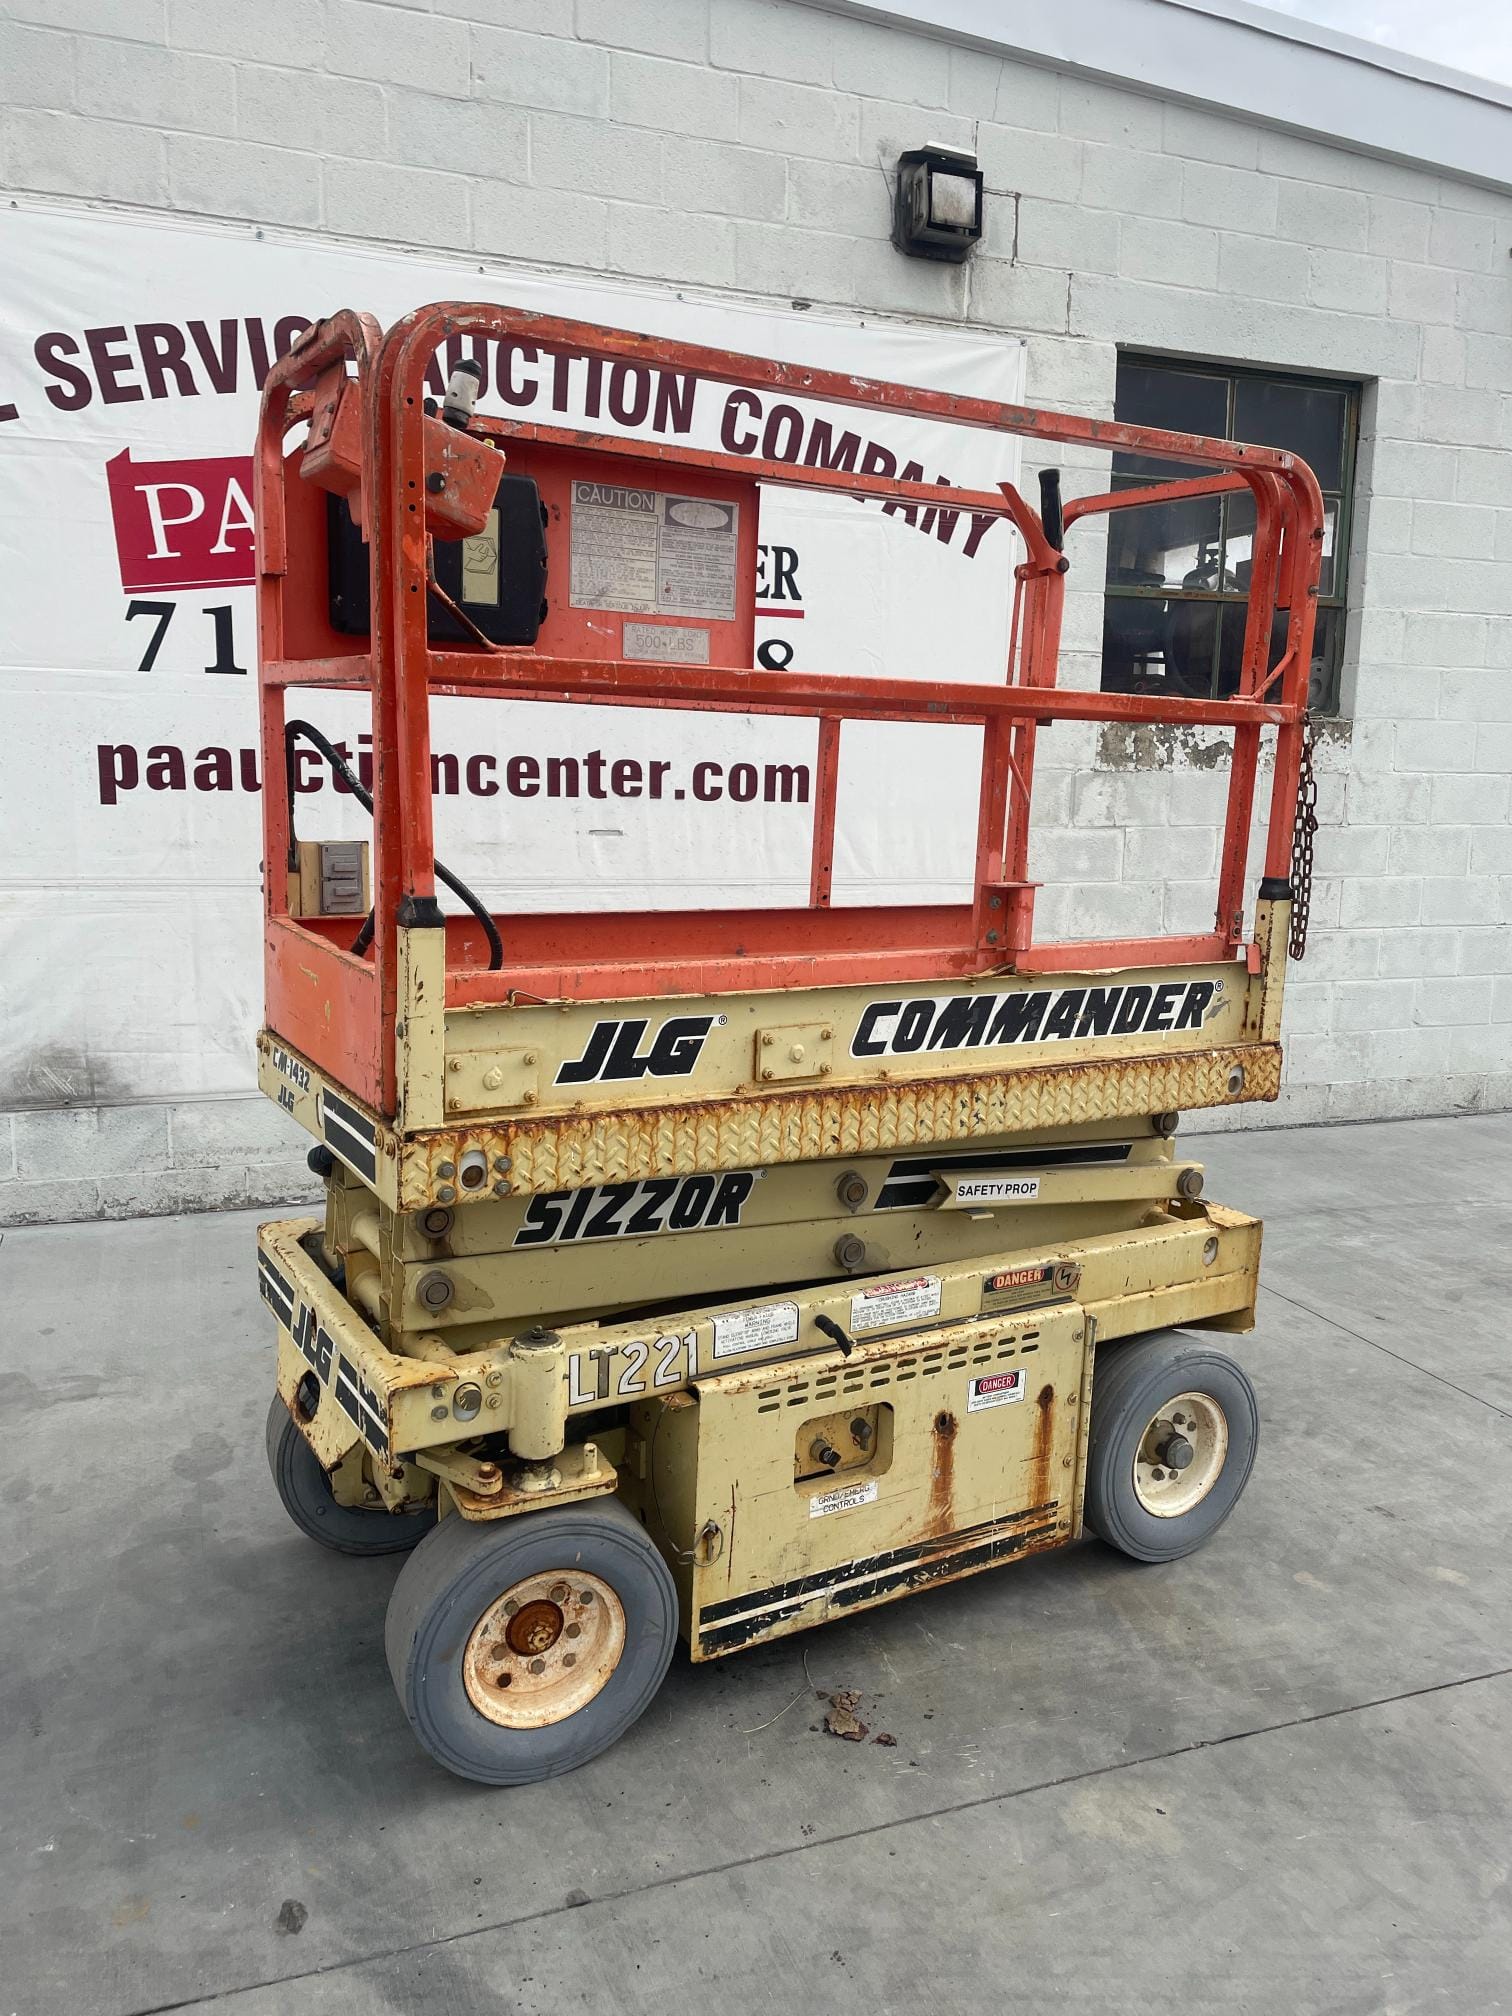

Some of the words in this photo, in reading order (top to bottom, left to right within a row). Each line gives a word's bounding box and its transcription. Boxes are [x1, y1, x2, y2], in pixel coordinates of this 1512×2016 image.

[34, 315, 340, 411] SERVIC
[721, 389, 1000, 558] COMPANY
[577, 484, 655, 511] CAUTION
[636, 634, 661, 649] 500
[669, 637, 694, 652] LBS
[97, 734, 810, 805] paauctincenter.com
[852, 981, 1215, 1057] COMMANDER
[271, 1046, 311, 1093] CM-1432
[555, 1016, 714, 1084] JLG
[277, 1083, 295, 1113] JLG
[514, 1172, 754, 1245] SIZZOR
[958, 1184, 1003, 1197] SAFETY
[1005, 1183, 1037, 1195] PROP
[995, 1268, 1042, 1288] DANGER
[292, 1300, 335, 1388] JLG
[568, 1332, 699, 1406] LT221
[982, 1377, 1012, 1391] DANGER
[823, 1495, 865, 1513] CONTROLS
